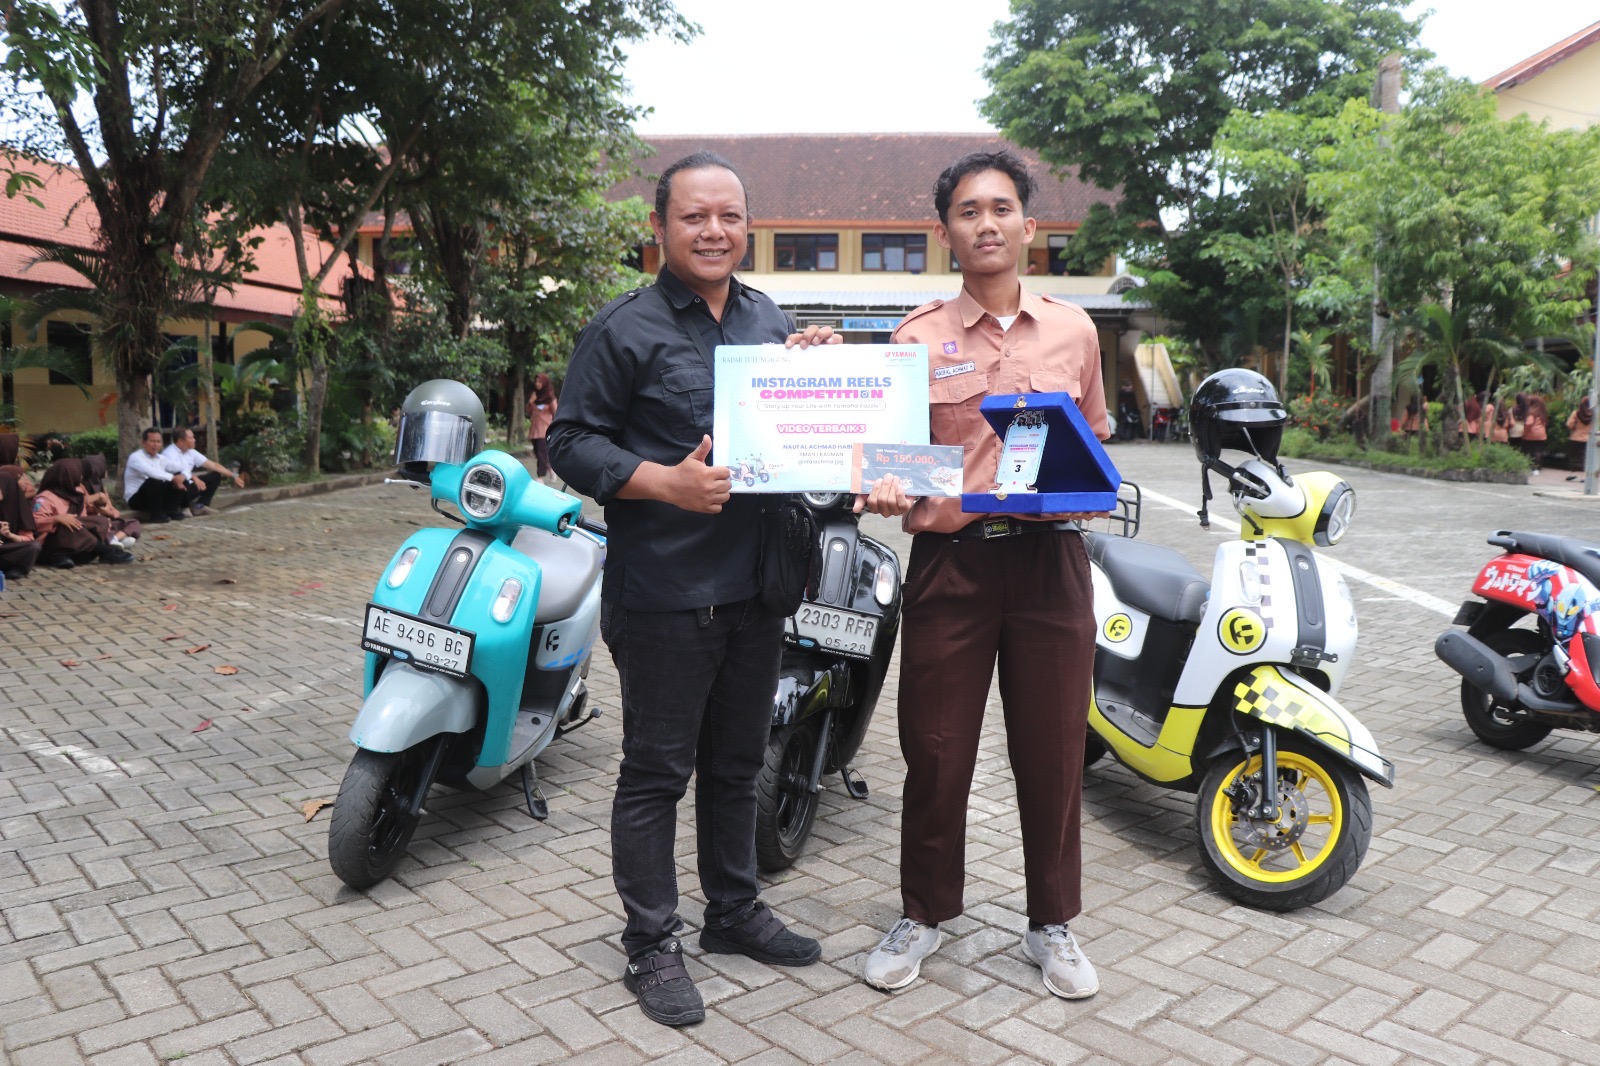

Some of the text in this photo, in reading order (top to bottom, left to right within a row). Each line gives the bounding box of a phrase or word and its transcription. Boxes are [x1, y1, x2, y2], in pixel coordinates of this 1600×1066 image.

[751, 376, 892, 388] INSTAGRAM REELS
[776, 423, 867, 434] VIDEO TERBAIK 3
[876, 453, 940, 466] Rp 150.000,-
[1015, 464, 1022, 473] 3
[1481, 565, 1543, 602] ウルトラマン
[800, 607, 875, 638] 2303 RFR
[373, 615, 463, 656] AE 9496 BG
[370, 642, 391, 655] YAMAHA
